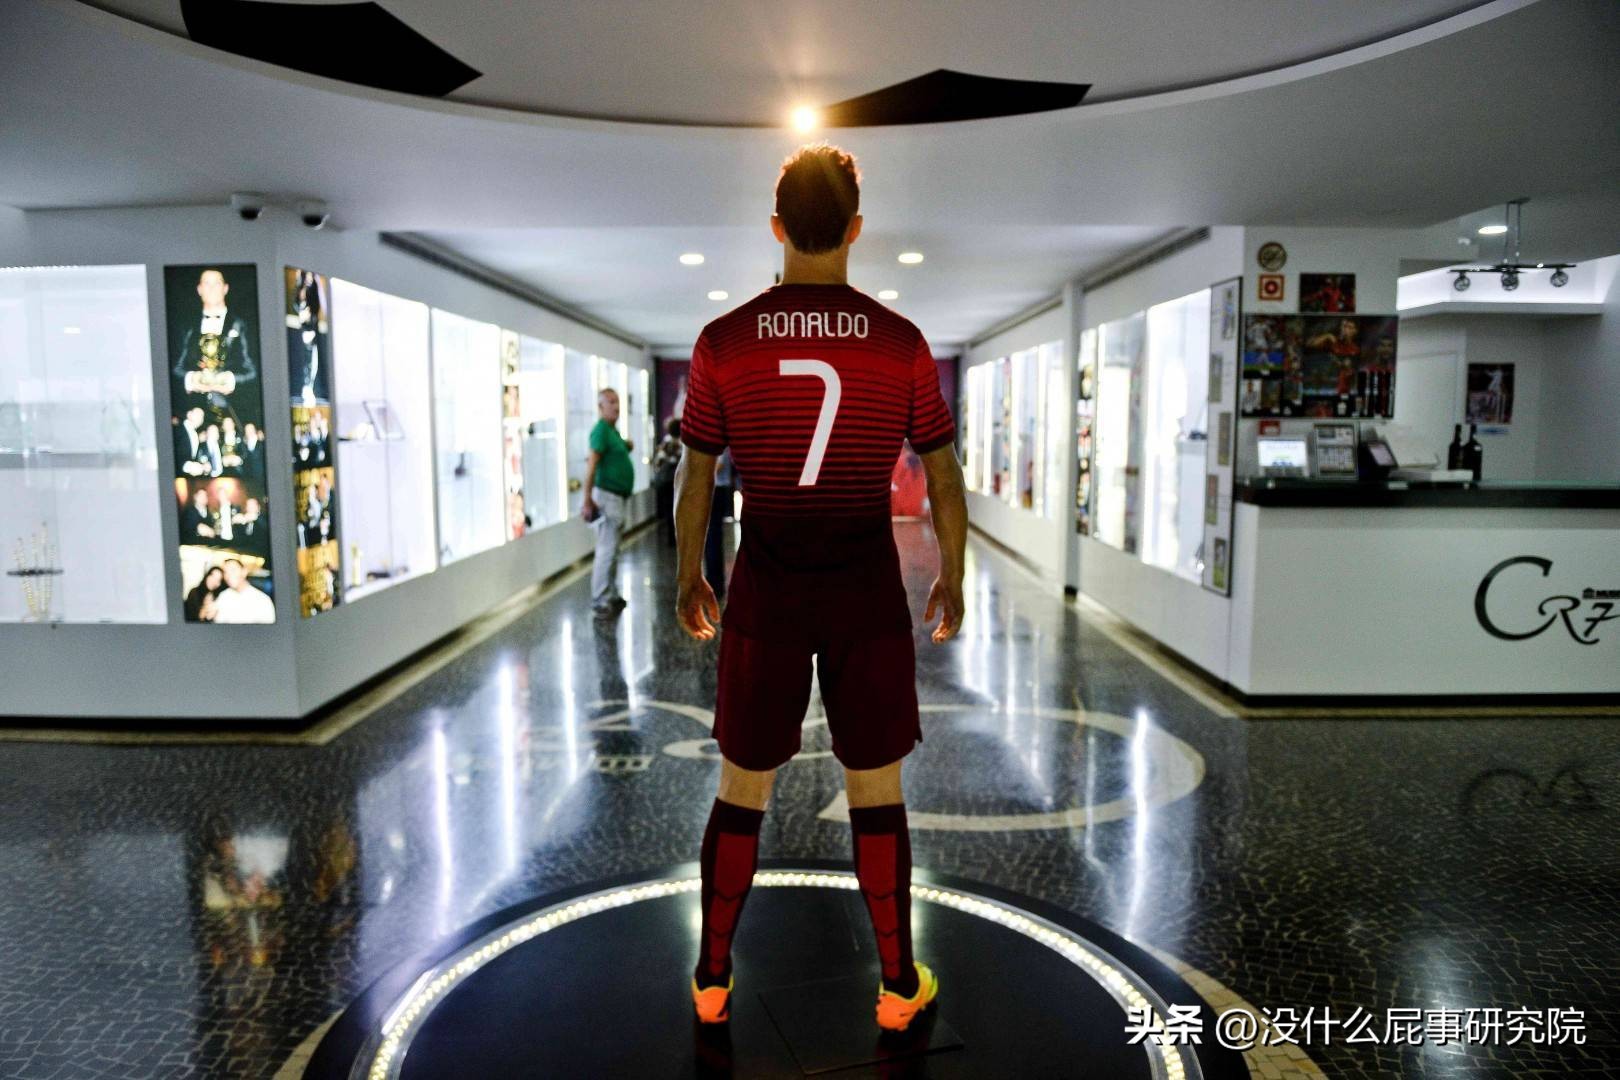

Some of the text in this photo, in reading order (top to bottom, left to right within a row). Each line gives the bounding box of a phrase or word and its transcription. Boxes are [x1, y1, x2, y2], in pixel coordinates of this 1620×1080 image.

[757, 311, 869, 340] RONALDO
[778, 358, 842, 487] 7
[1474, 554, 1620, 646] CR7
